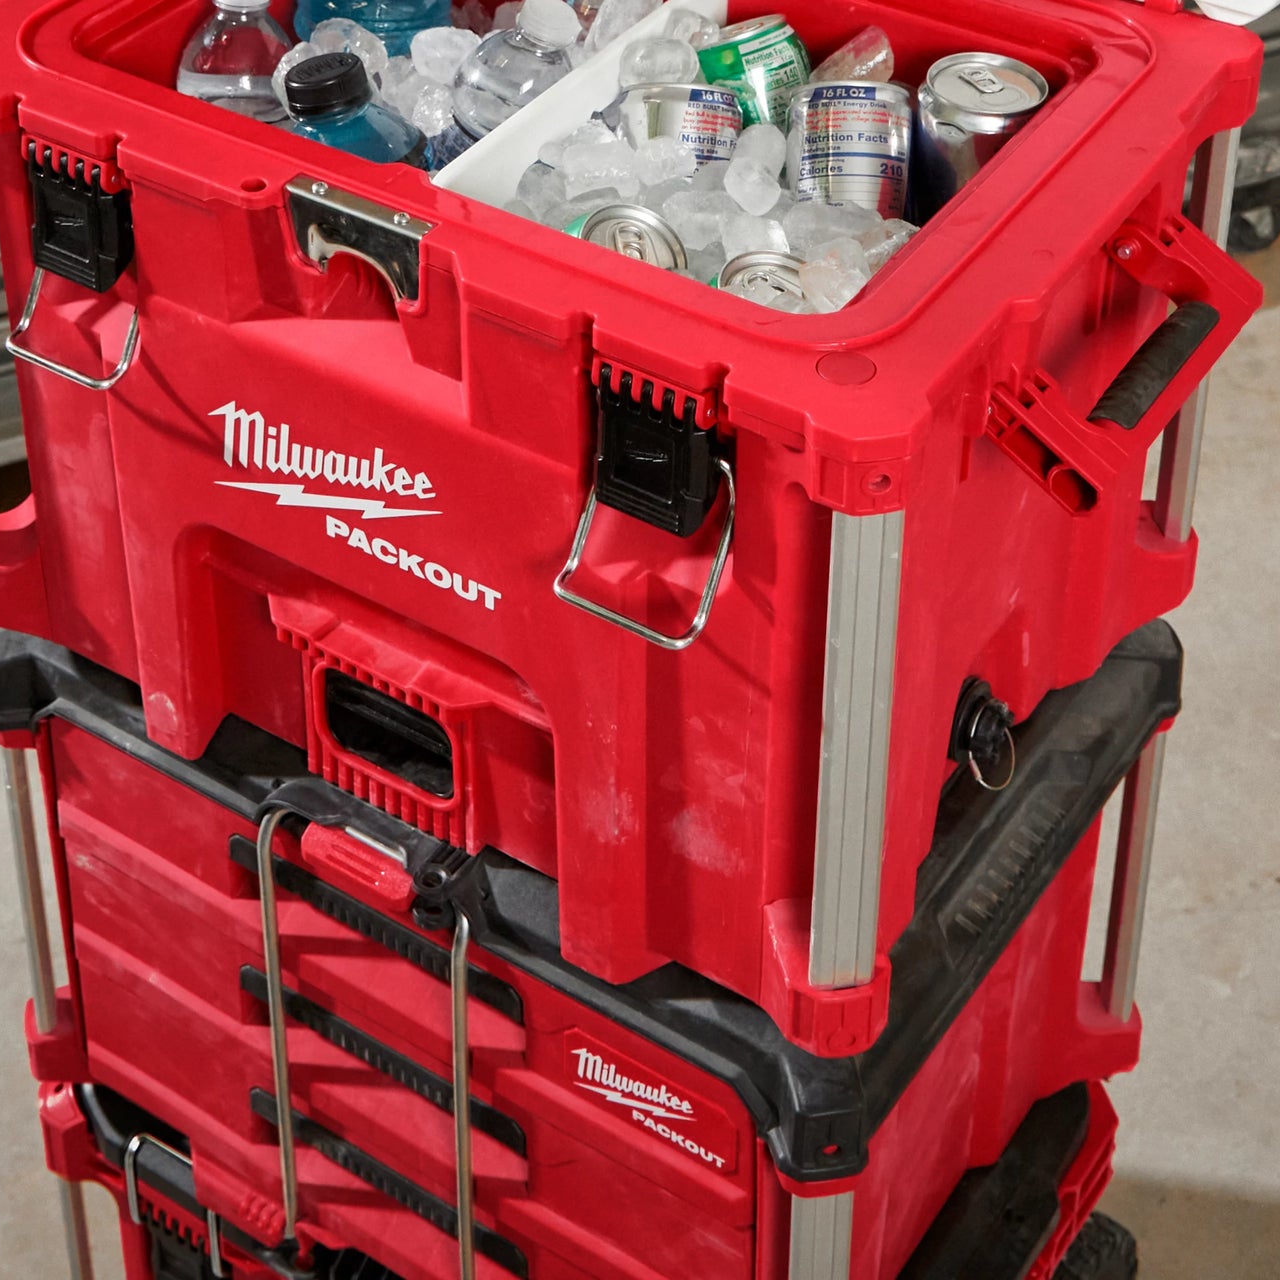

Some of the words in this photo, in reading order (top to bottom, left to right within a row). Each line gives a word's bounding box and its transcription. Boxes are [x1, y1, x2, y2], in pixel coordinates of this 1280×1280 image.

[744, 51, 773, 66] Nutrition
[784, 66, 798, 80] 140
[701, 91, 713, 100] 16
[714, 92, 723, 102] FL
[822, 89, 834, 98] 16
[836, 88, 847, 97] FL
[849, 88, 866, 97] OZ
[681, 134, 728, 148] Nutrition
[805, 133, 853, 145] Nutrition
[858, 133, 888, 144] Facts
[800, 164, 843, 177] Calories
[880, 163, 903, 178] 210
[208, 400, 436, 499] Milwaukee
[326, 514, 502, 611] PACKOUT
[571, 1048, 694, 1114] Milwaukee
[632, 1109, 726, 1168] PACKOUT
